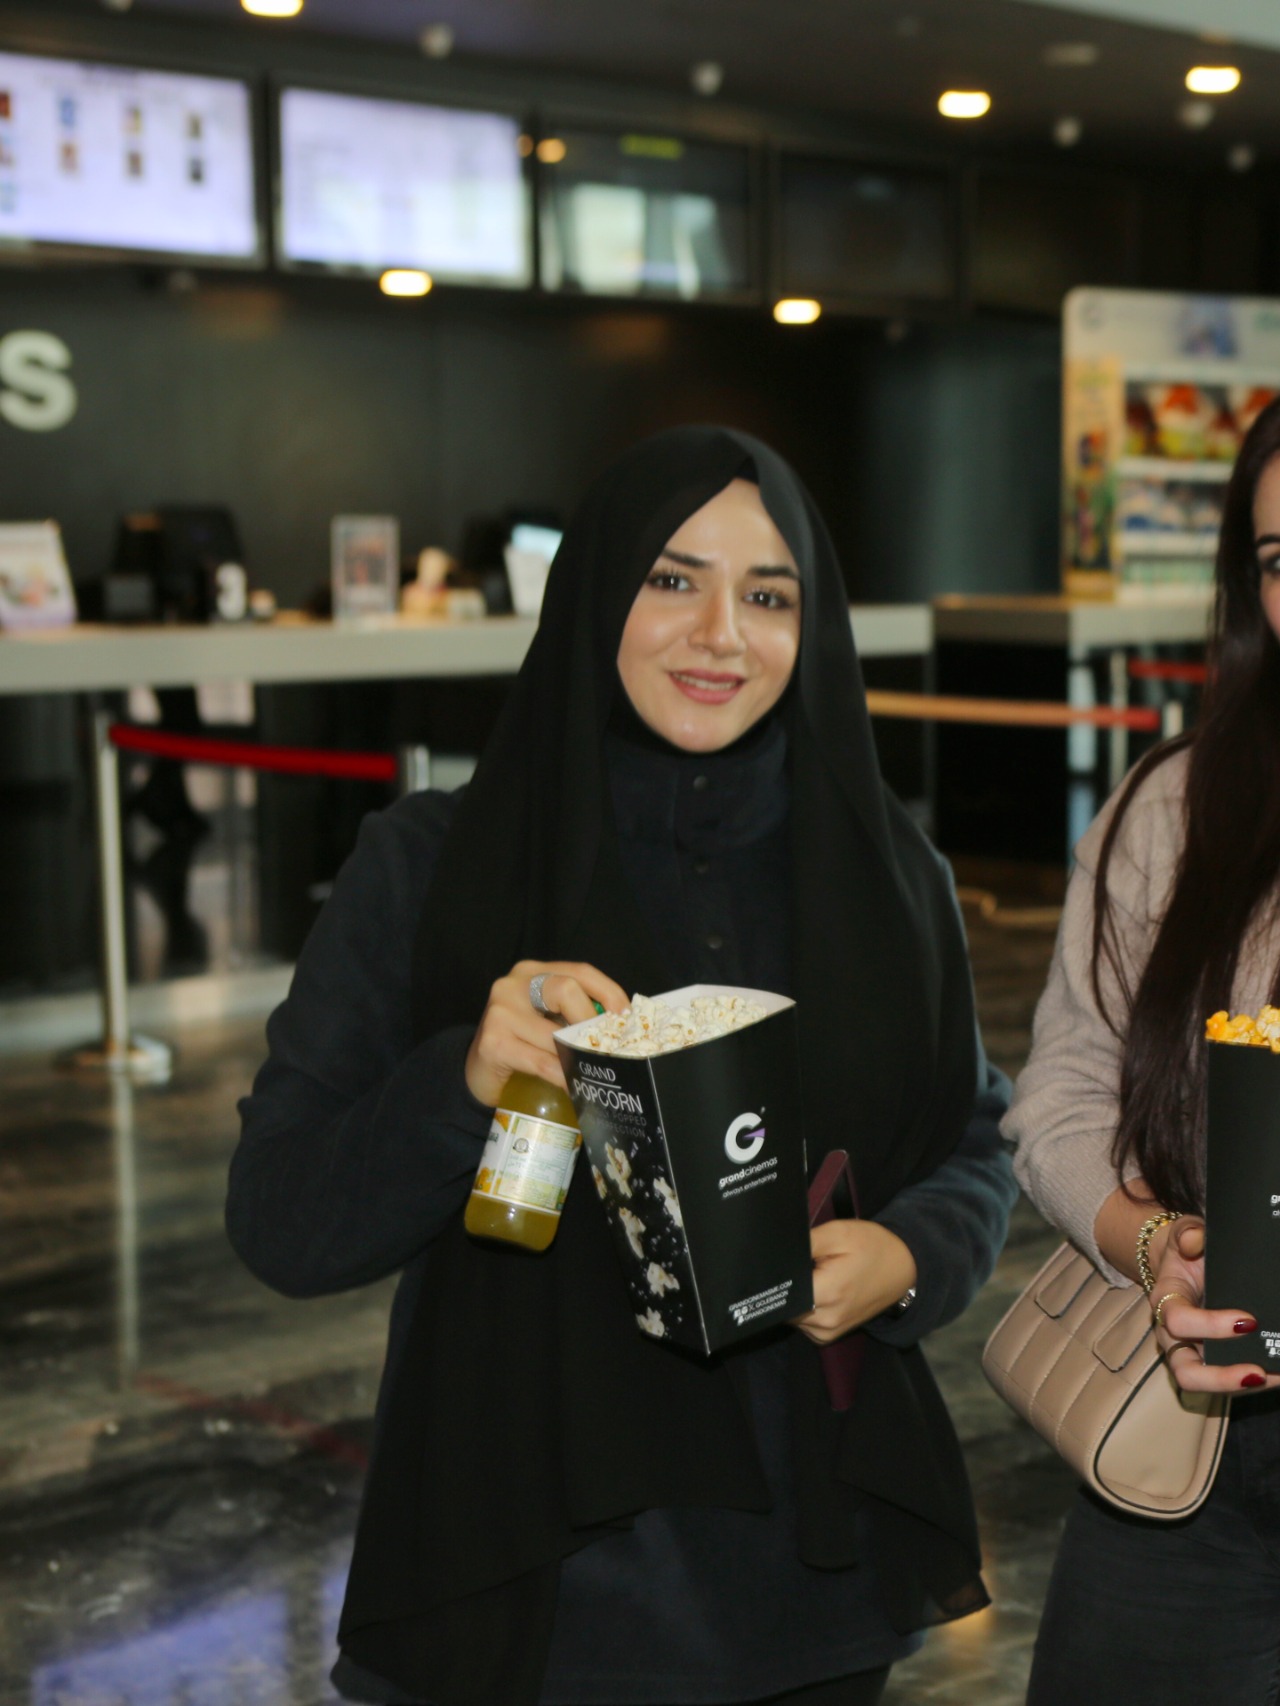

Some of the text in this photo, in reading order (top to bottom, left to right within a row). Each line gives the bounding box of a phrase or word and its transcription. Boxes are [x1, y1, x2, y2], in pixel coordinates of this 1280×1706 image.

[579, 1061, 616, 1082] GRAND
[573, 1078, 644, 1114] POPCORN
[719, 1156, 778, 1189] grandcinemas
[722, 1172, 778, 1199] always entertaining
[755, 1290, 788, 1309] GCLEBANON
